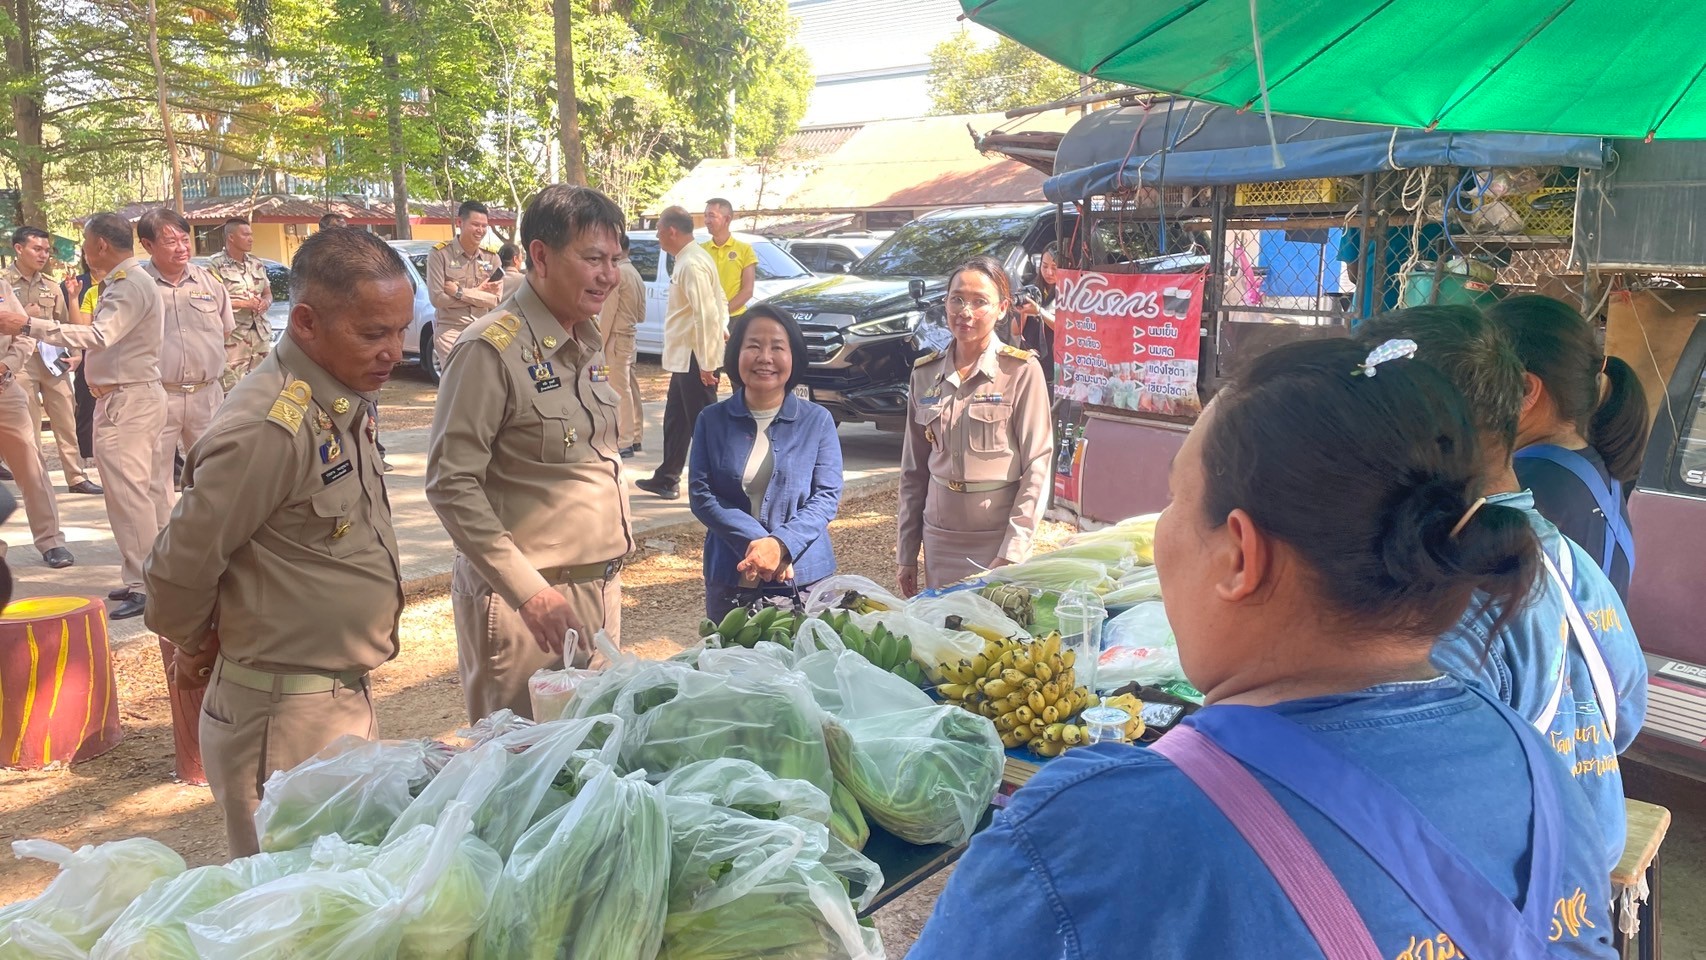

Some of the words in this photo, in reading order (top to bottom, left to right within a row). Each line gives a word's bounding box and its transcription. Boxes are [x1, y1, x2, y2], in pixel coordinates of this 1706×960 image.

[791, 312, 813, 321] UZU
[1075, 317, 1097, 332] ชาเย็น
[1147, 322, 1178, 338] นมเย็น
[1148, 345, 1174, 357] นมสด
[1148, 363, 1185, 377] แดงโซดา
[795, 387, 808, 398] 020
